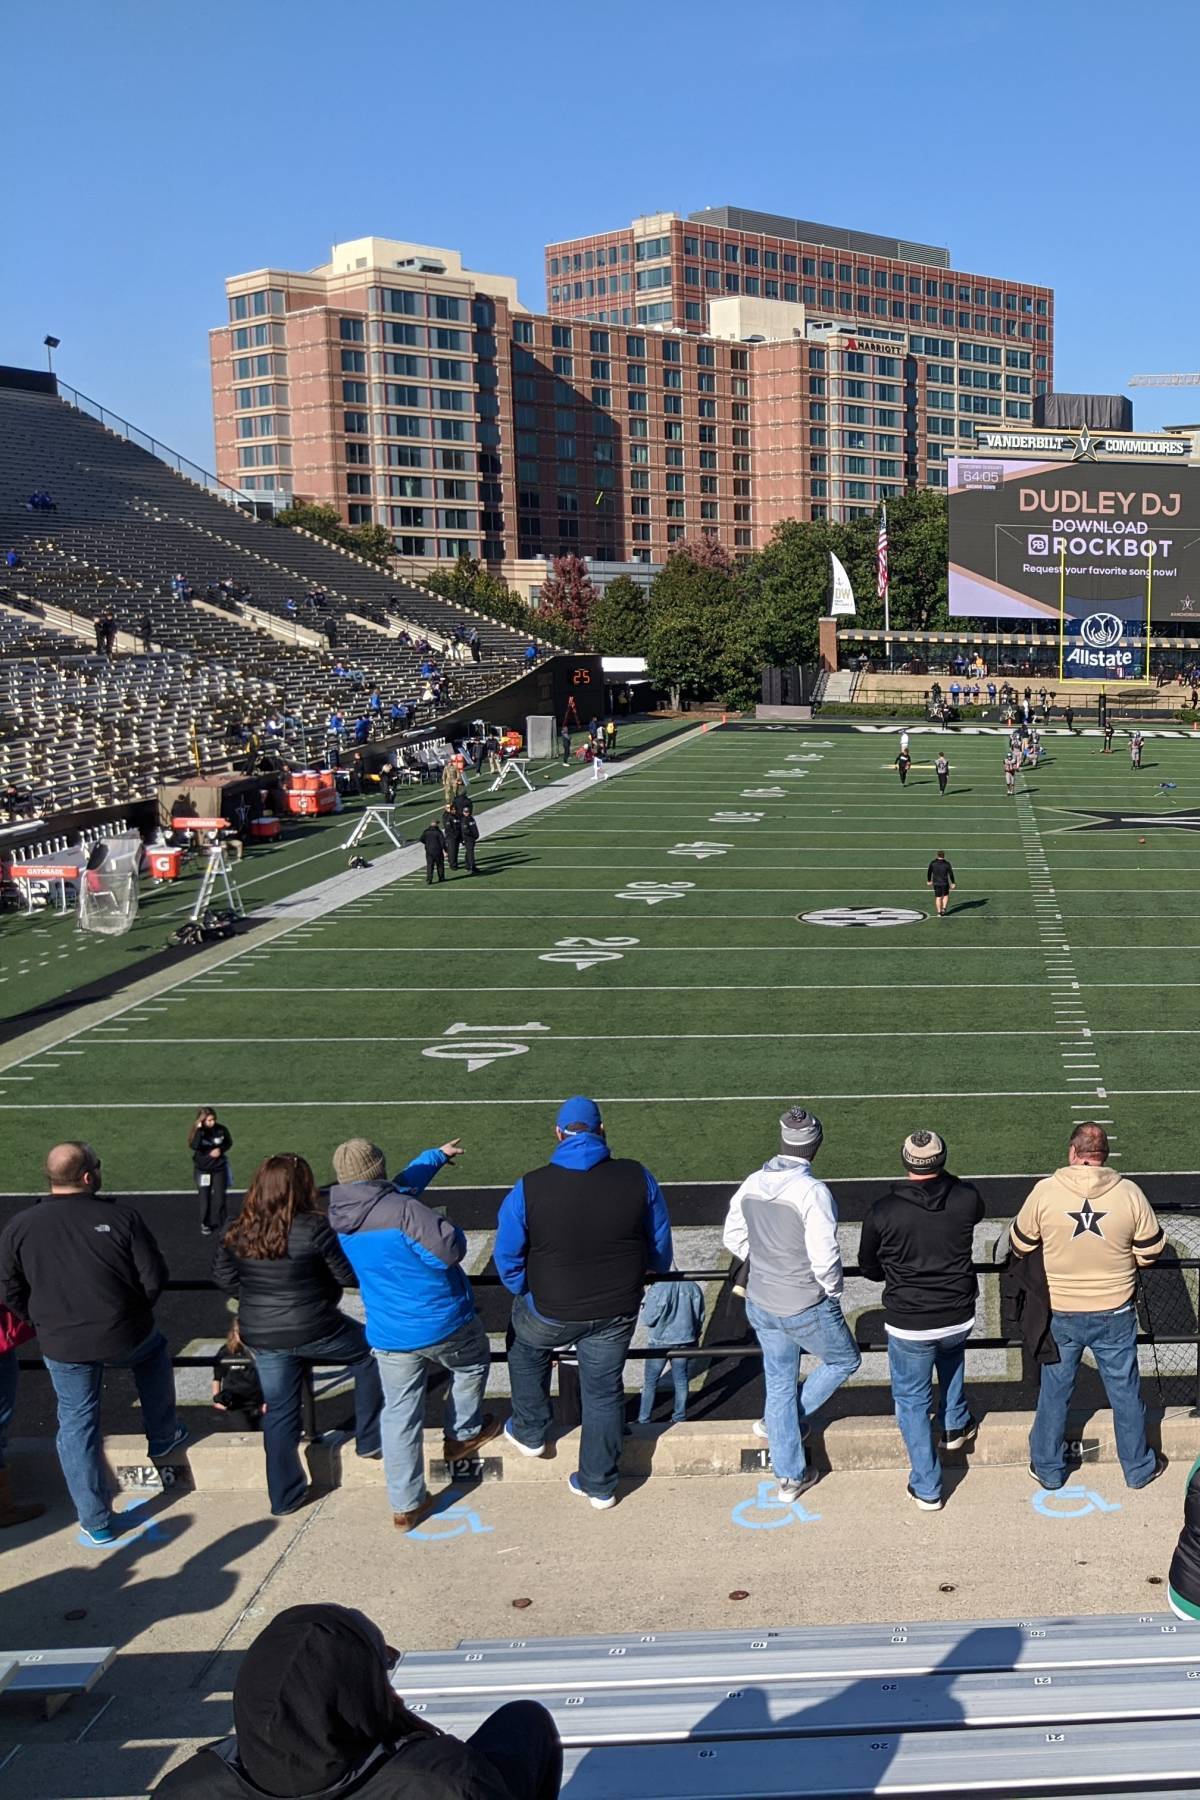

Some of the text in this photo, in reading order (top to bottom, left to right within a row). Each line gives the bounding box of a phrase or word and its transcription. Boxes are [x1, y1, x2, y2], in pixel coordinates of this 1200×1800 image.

[858, 341, 901, 354] MARRIOTT
[987, 435, 1064, 449] VANDERBILT
[1080, 438, 1090, 451] V
[1106, 440, 1184, 453] COMMODORES
[963, 471, 999, 483] 64:05
[1019, 488, 1181, 516] DUDLEY DJ
[1052, 519, 1148, 535] DOWNLOAD
[1053, 537, 1173, 558] ROCKBOT
[1023, 564, 1177, 578] Request your favorite song now!
[1066, 648, 1132, 667] Allstate
[573, 670, 590, 684] 25
[157, 857, 170, 870] G
[614, 881, 696, 900] 30
[538, 936, 641, 963] 20
[422, 1021, 551, 1058] 10
[1080, 1213, 1094, 1230] V
[447, 1459, 486, 1476] 127
[136, 1467, 175, 1485] 126
[870, 1742, 888, 1750] 20
